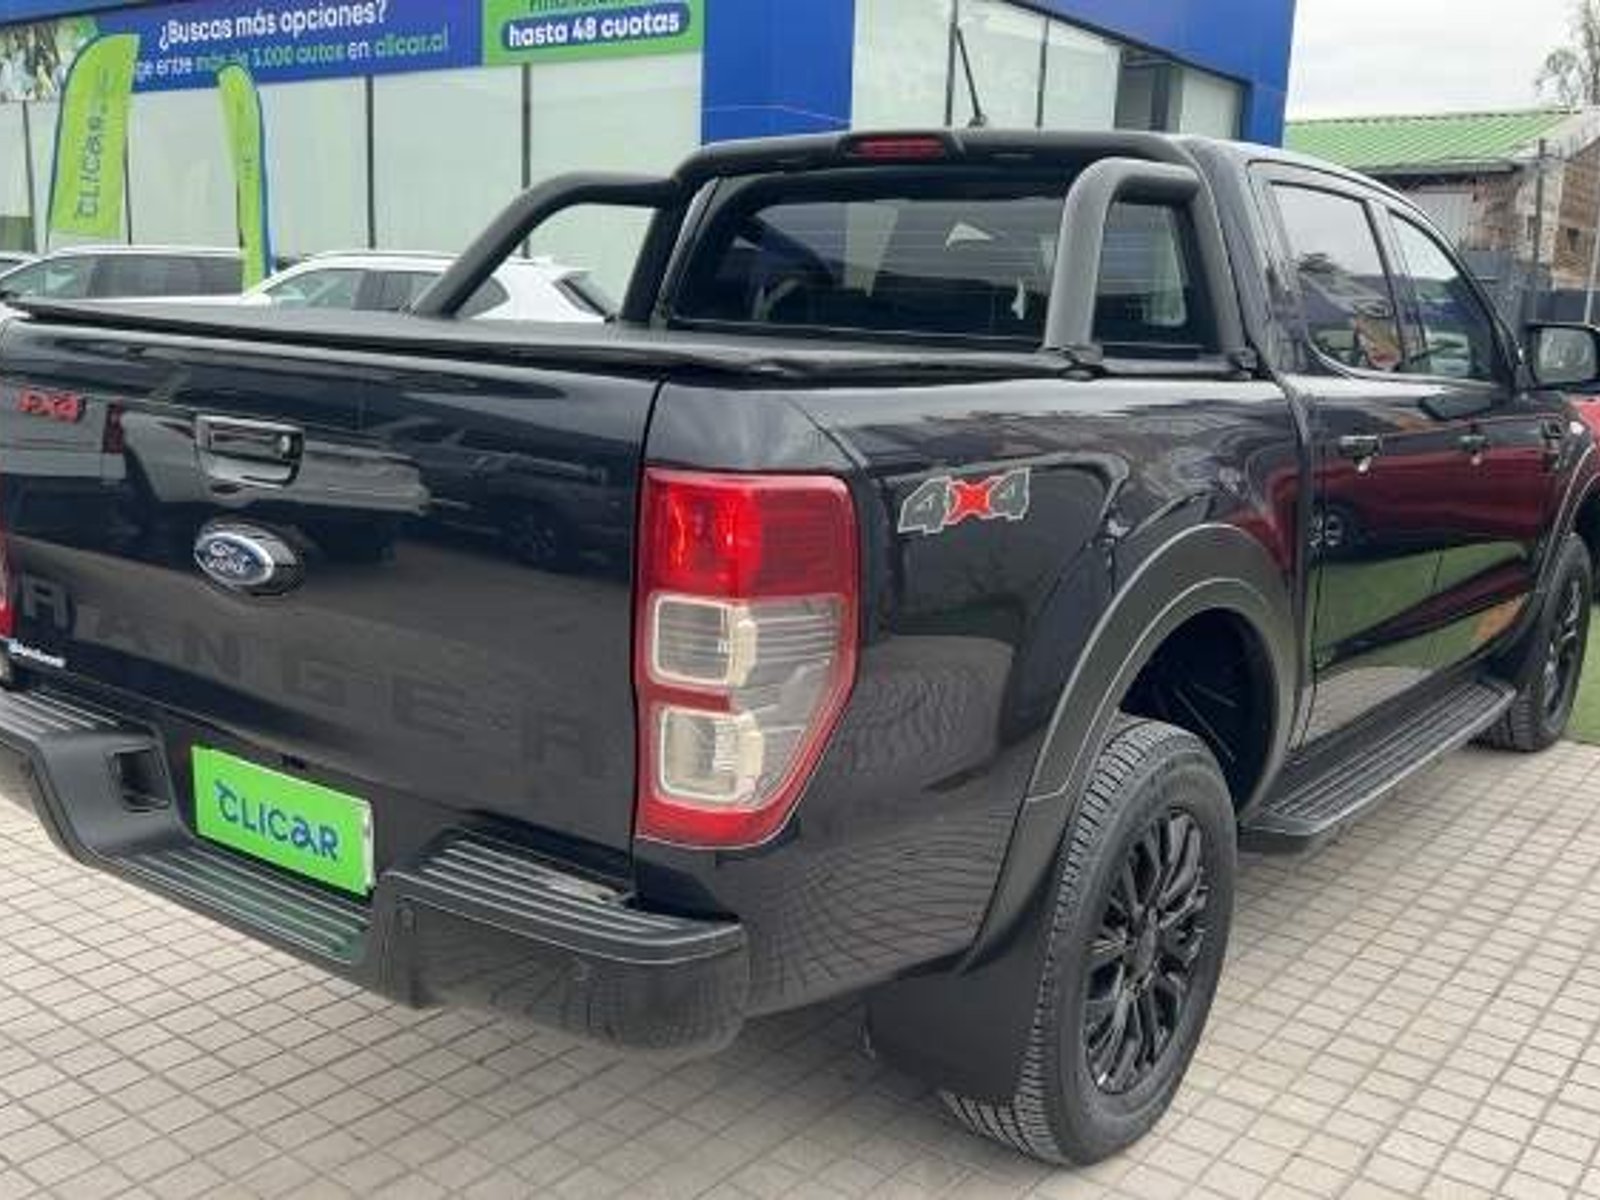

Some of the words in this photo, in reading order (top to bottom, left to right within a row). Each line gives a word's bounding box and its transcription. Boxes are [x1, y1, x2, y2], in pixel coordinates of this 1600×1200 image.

[159, 20, 231, 50] ¿Buscas
[234, 12, 278, 37] más
[280, 0, 386, 39] opciones?
[509, 23, 568, 47] hasta
[573, 16, 597, 40] 48
[600, 11, 679, 38] cuotas
[348, 39, 370, 61] en
